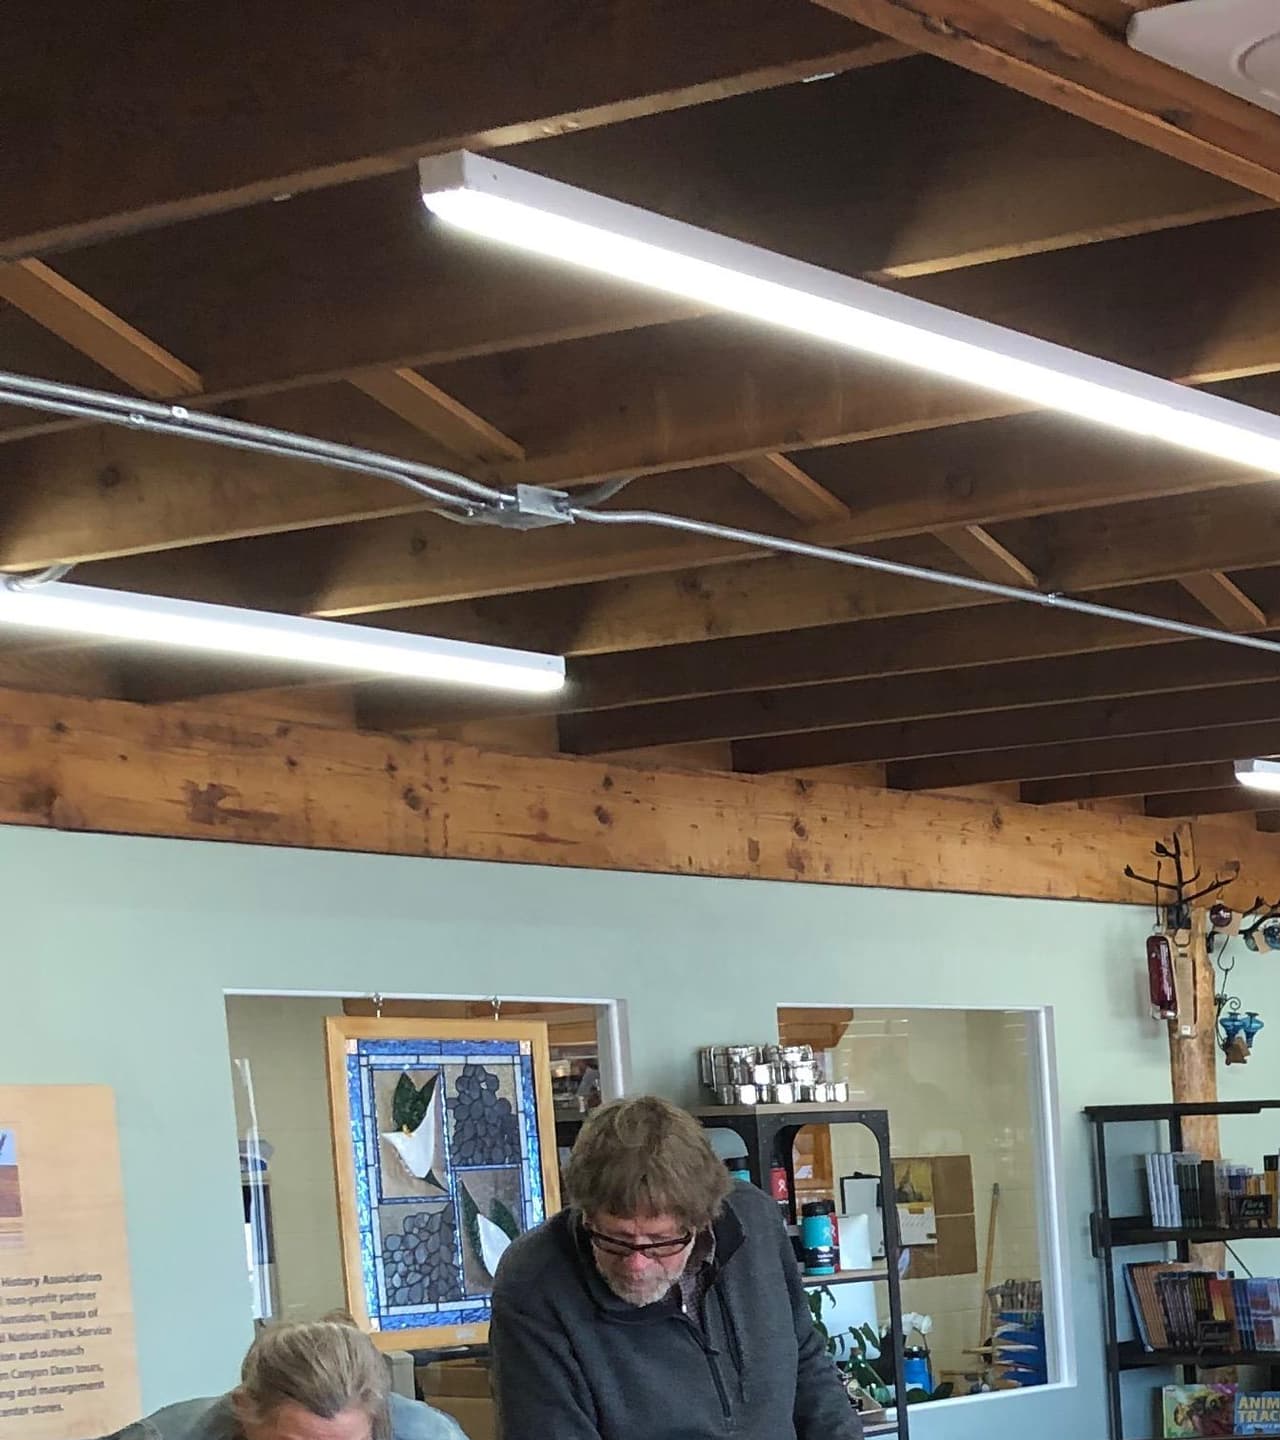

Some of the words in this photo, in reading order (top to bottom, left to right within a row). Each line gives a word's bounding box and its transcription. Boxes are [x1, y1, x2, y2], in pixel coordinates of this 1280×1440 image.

[1, 1277, 40, 1288] History
[42, 1273, 103, 1284] Association
[5, 1293, 57, 1305] non-profit
[59, 1292, 97, 1304] partner
[50, 1310, 86, 1321] Bureau
[87, 1308, 98, 1318] of
[7, 1330, 51, 1341] National
[52, 1328, 75, 1338] Park
[76, 1326, 112, 1337] Service
[18, 1349, 38, 1360] and
[40, 1346, 84, 1358] outreach
[10, 1368, 49, 1380] Canyon
[50, 1365, 74, 1376] Dam
[17, 1384, 37, 1397] and
[38, 1380, 105, 1395] management
